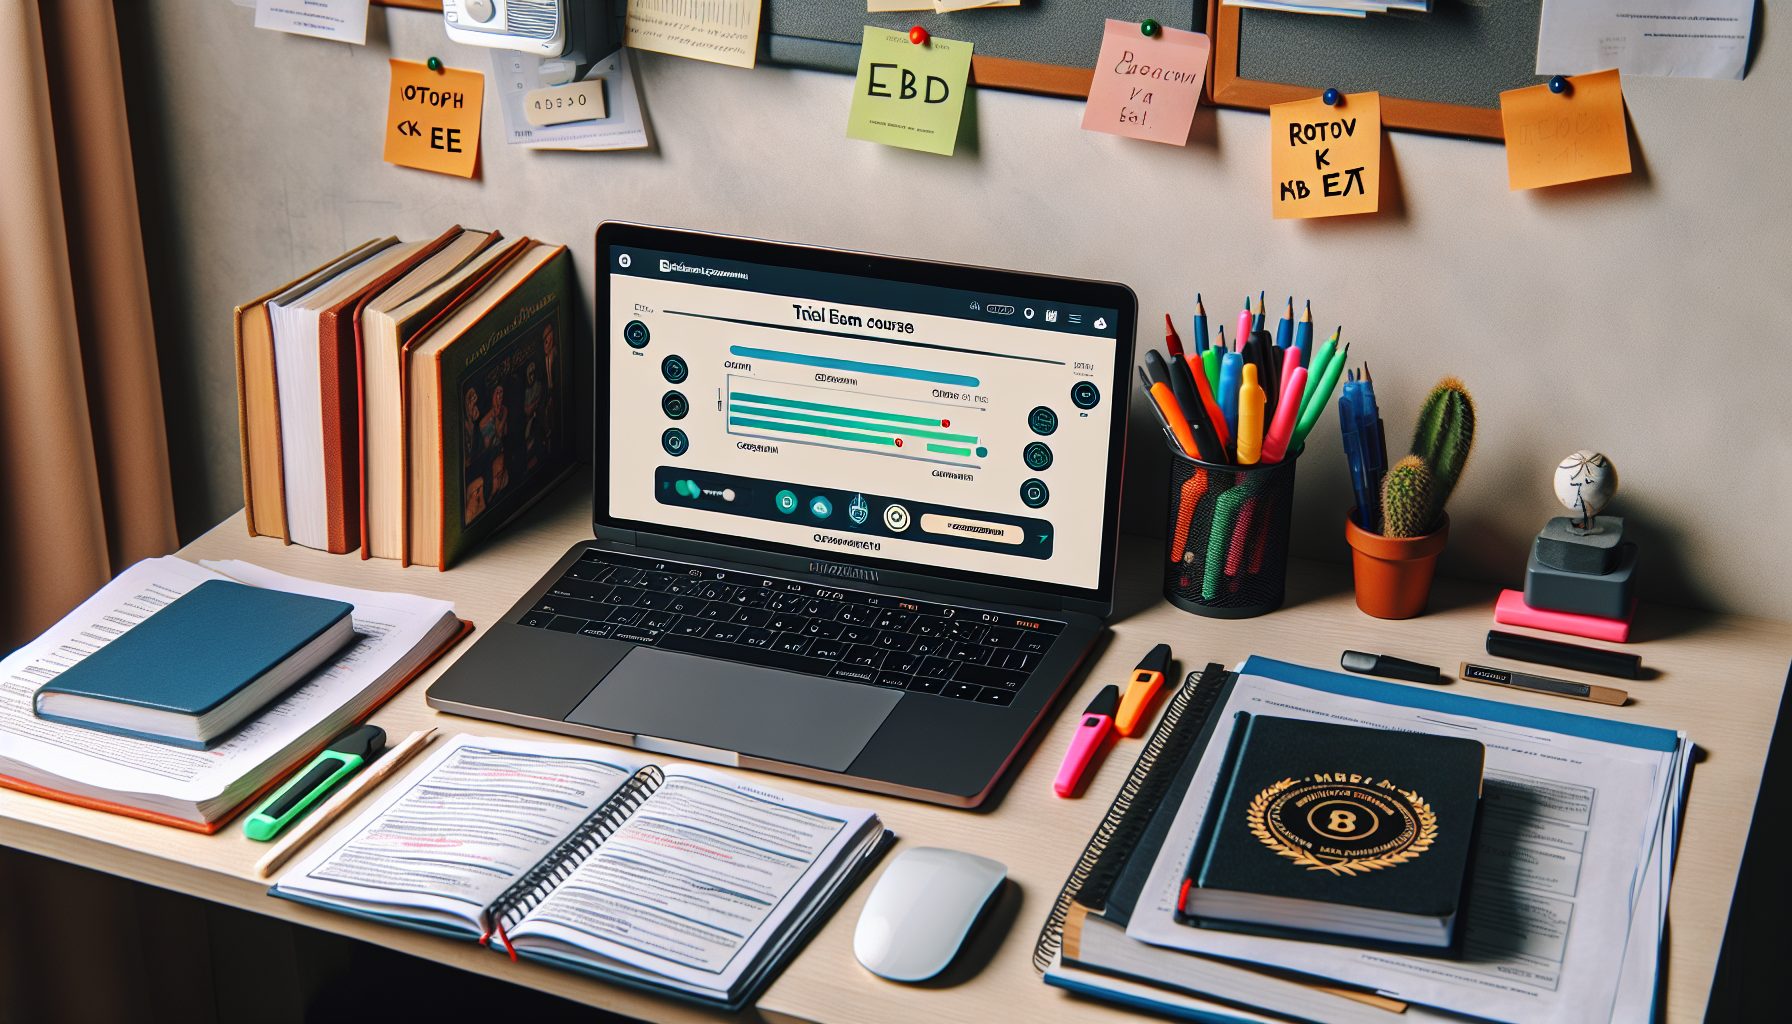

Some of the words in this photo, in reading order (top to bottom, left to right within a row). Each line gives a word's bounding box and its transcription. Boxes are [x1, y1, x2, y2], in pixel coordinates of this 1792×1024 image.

[868, 62, 949, 104] EBD
[430, 126, 462, 153] EE
[1289, 117, 1357, 147] ROTOV
[1315, 147, 1331, 171] K
